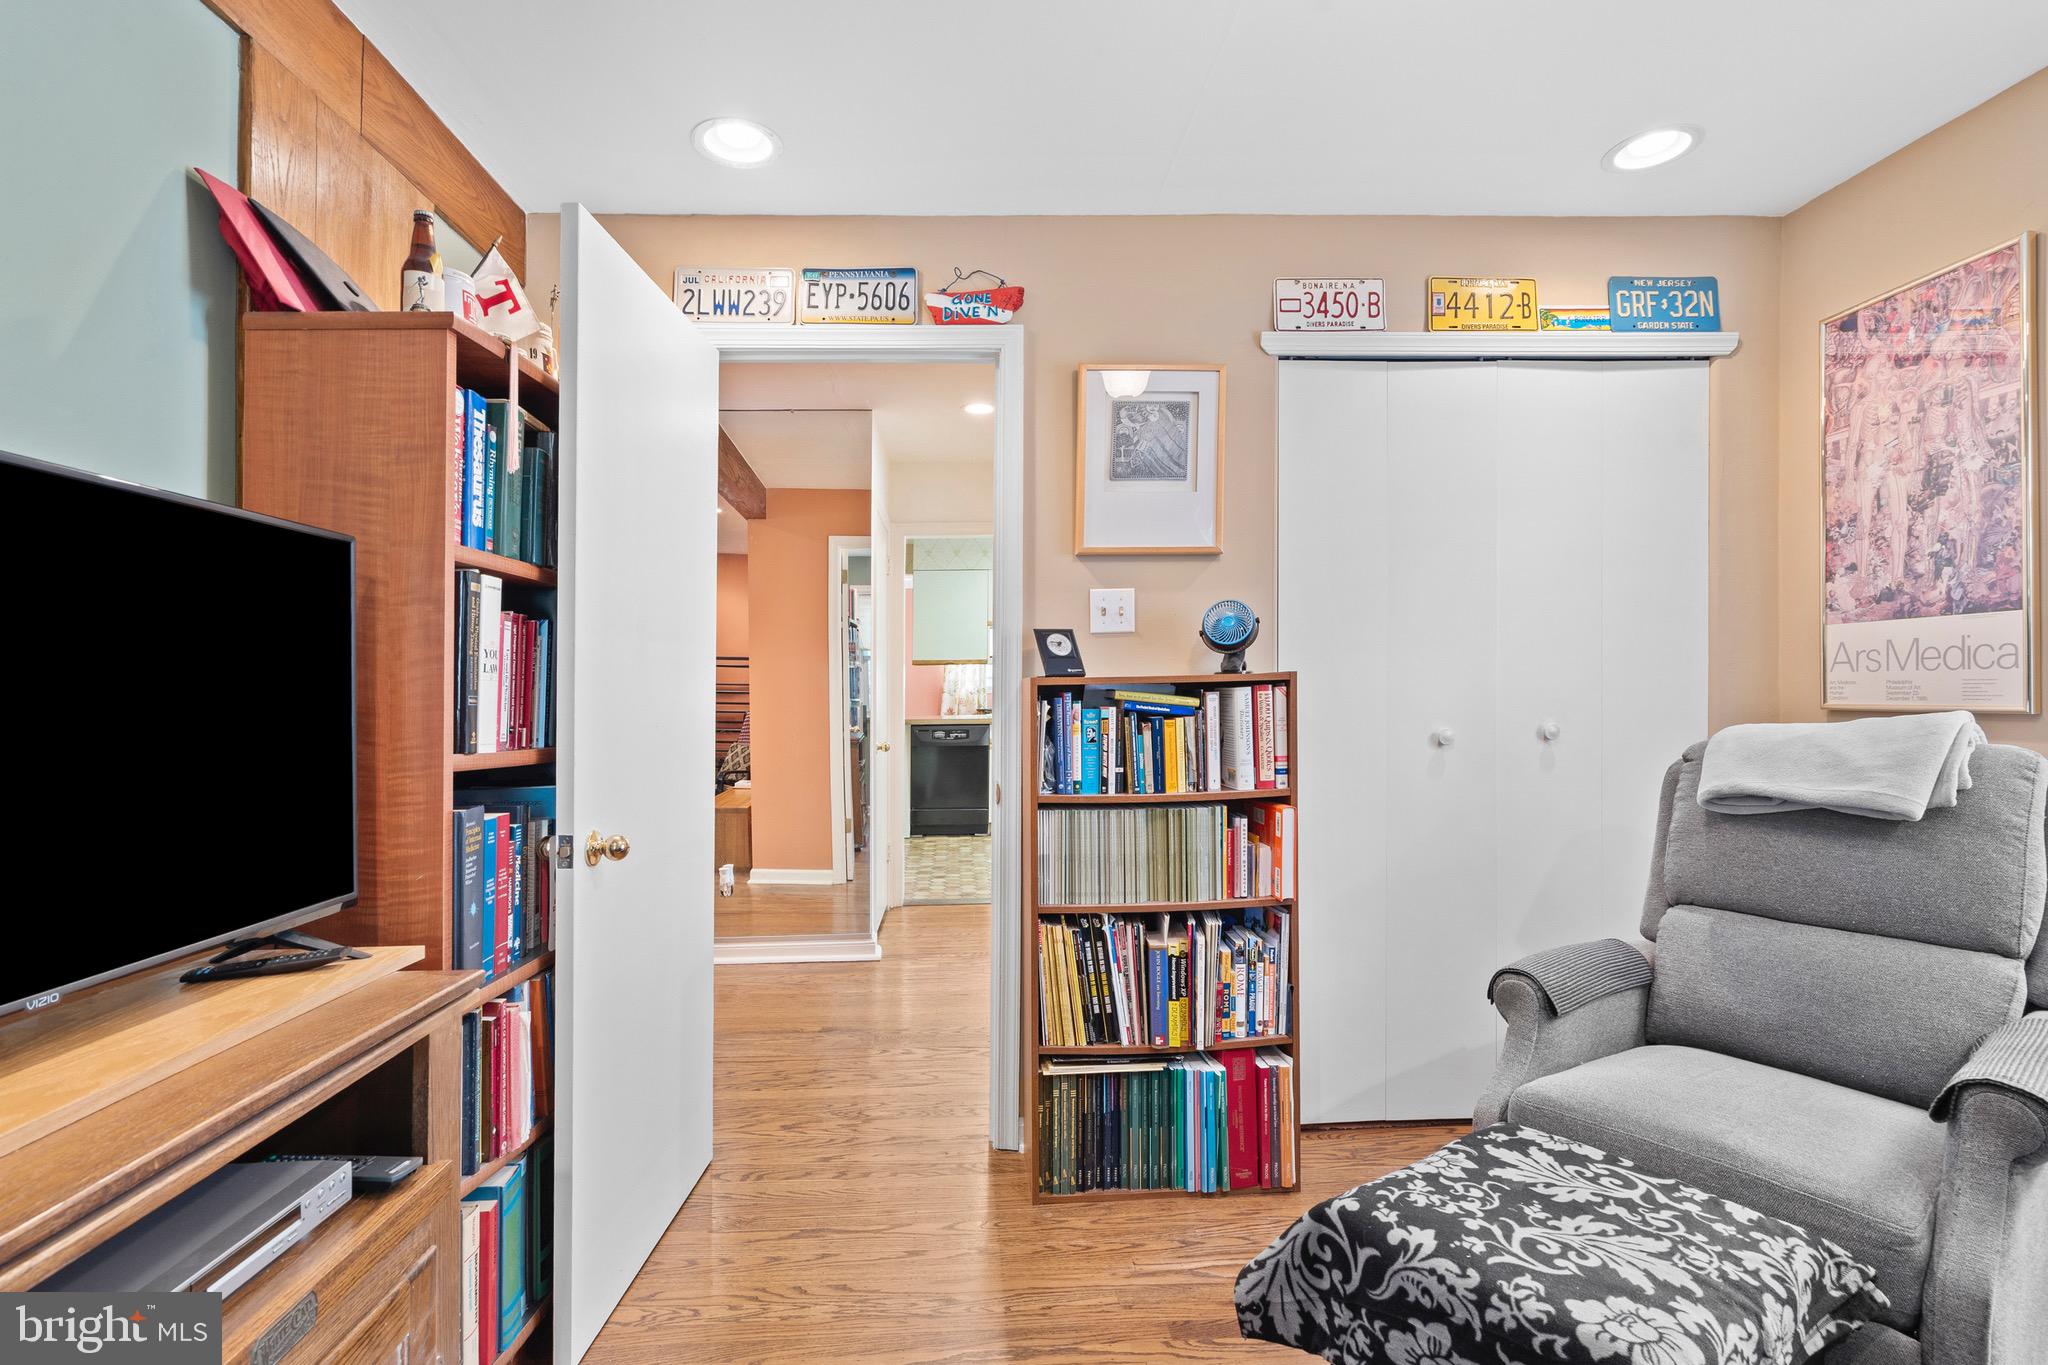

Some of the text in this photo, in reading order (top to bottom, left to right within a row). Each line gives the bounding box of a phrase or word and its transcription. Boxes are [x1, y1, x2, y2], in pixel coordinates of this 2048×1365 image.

[704, 275, 767, 284] CALIFORNIA
[829, 270, 889, 279] PENNSYLVANIA
[475, 278, 522, 317] T
[682, 288, 787, 317] 2LWW239
[951, 292, 992, 305] GONE
[1482, 323, 1509, 331] PARADISE
[1671, 321, 1695, 329] STATE
[472, 409, 485, 527] Thesaurus
[487, 449, 497, 496] Rhyming
[1265, 746, 1273, 771] Quotes
[514, 854, 522, 906] Medicine
[1181, 987, 1187, 996] XP
[1236, 967, 1245, 997] ROME
[26, 992, 60, 1010] VIZIO
